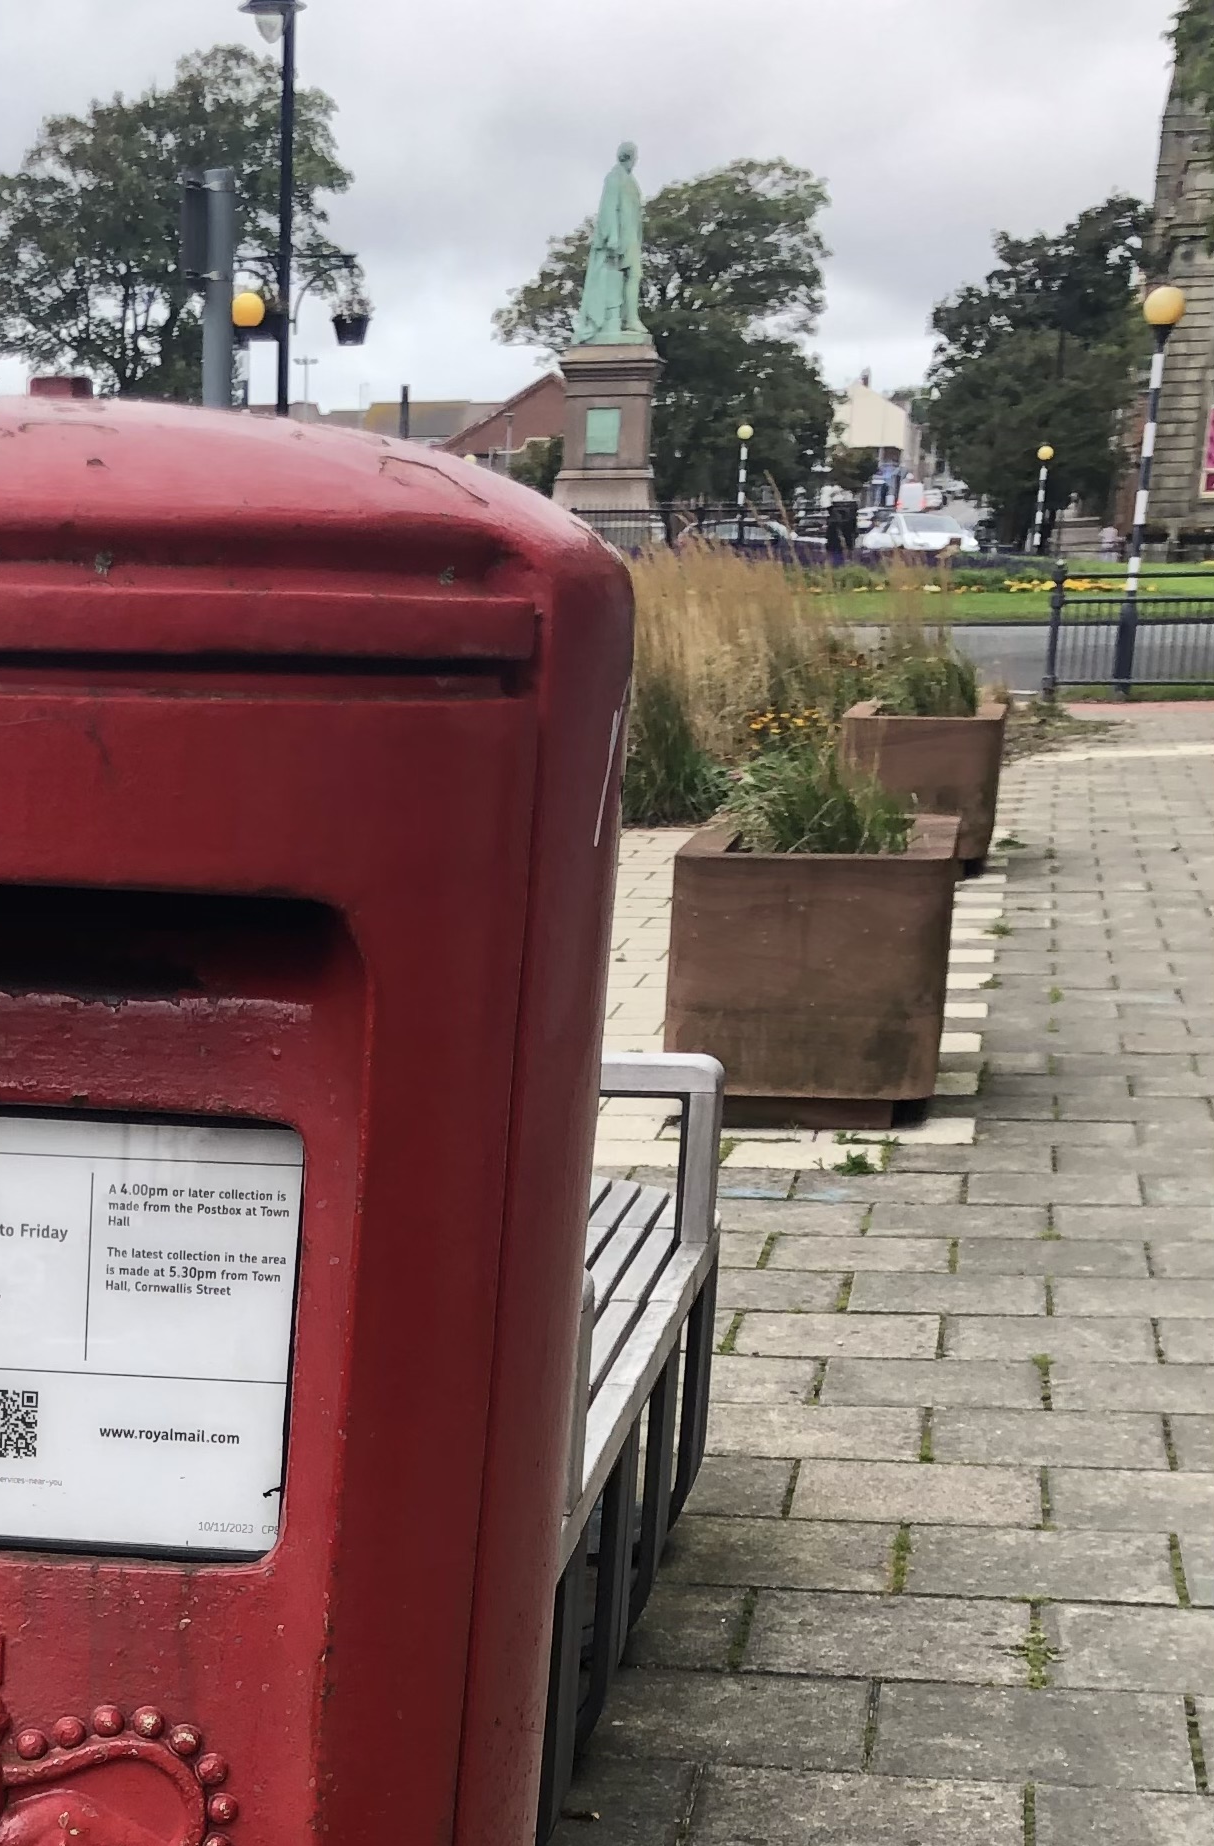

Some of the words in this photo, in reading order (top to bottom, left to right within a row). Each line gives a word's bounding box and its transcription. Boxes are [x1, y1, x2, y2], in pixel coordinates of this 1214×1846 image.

[109, 1184, 116, 1194] A
[120, 1183, 168, 1198] 4.00pm
[172, 1188, 185, 1197] or
[189, 1188, 215, 1198] later
[219, 1189, 273, 1201] collection
[277, 1191, 286, 1201] is
[108, 1201, 139, 1211] made
[144, 1201, 170, 1213] from
[175, 1203, 192, 1213] the
[197, 1204, 241, 1216] Postbox
[246, 1206, 256, 1216] at
[260, 1206, 289, 1217] Town
[108, 1216, 130, 1226] Hall
[0, 1223, 14, 1237] to
[21, 1223, 68, 1243] Friday
[107, 1247, 127, 1258] The
[132, 1248, 163, 1260] latest
[167, 1250, 220, 1262] collection
[224, 1252, 234, 1262] in
[240, 1254, 257, 1263] the
[261, 1256, 286, 1264] area
[106, 1265, 114, 1274] is
[119, 1265, 149, 1277] made
[154, 1268, 165, 1277] at
[169, 1266, 217, 1281] 5.30pm
[221, 1270, 248, 1280] from
[252, 1271, 280, 1282] Town
[106, 1280, 130, 1292] Hall,
[135, 1282, 192, 1294] Cornwallis
[196, 1284, 231, 1295] Street
[99, 1427, 240, 1444] www.royalmail.com
[198, 1521, 254, 1534] 10/11/2023
